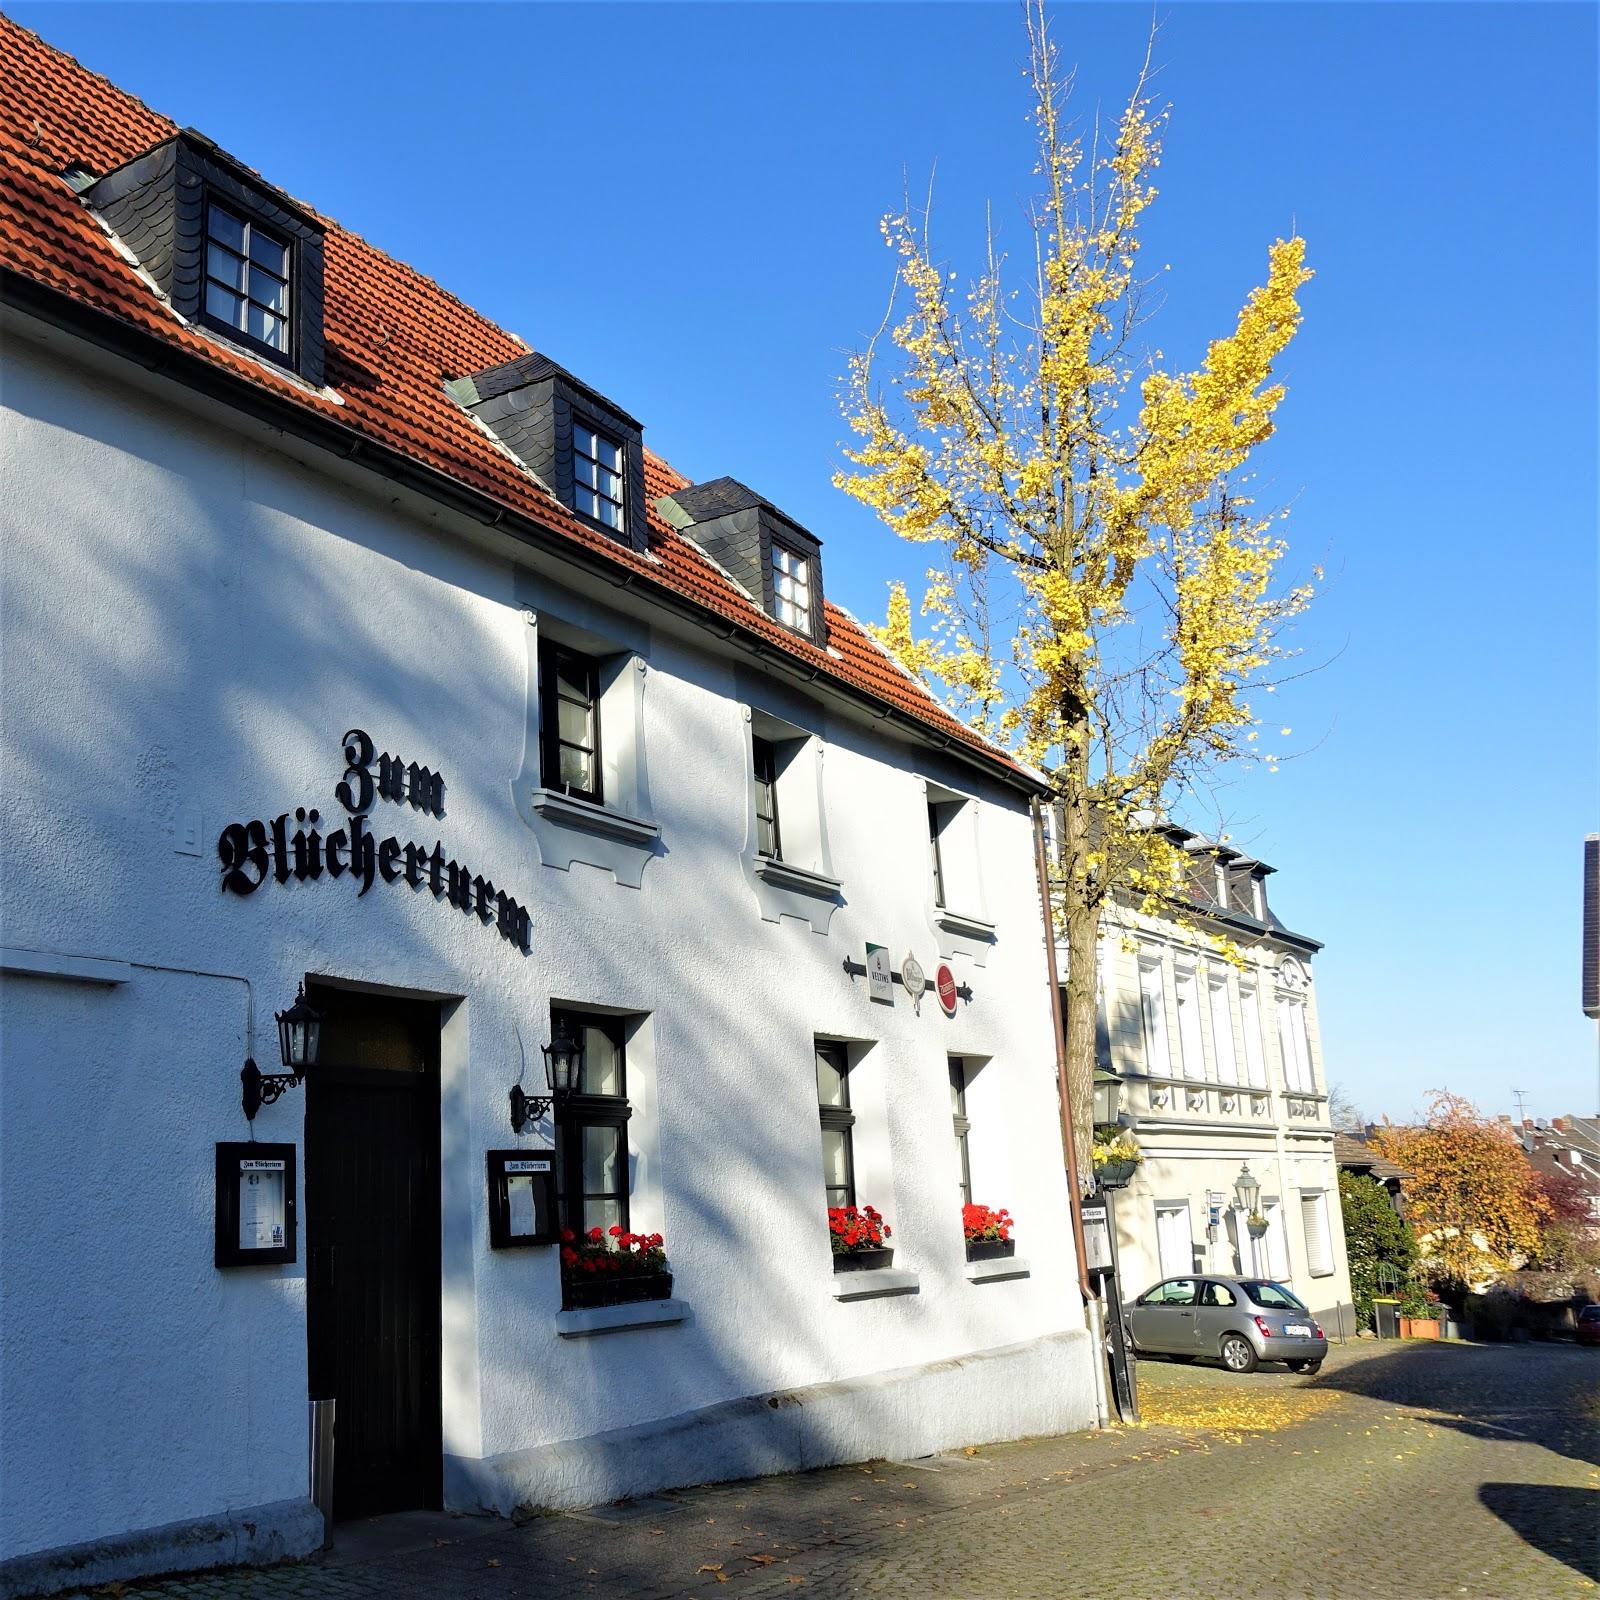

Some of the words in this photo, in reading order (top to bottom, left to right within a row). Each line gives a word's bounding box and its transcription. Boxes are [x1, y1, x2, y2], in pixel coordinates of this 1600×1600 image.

[335, 728, 446, 820] Zum
[218, 806, 532, 956] Blücherturm
[871, 971, 889, 984] VELTINS
